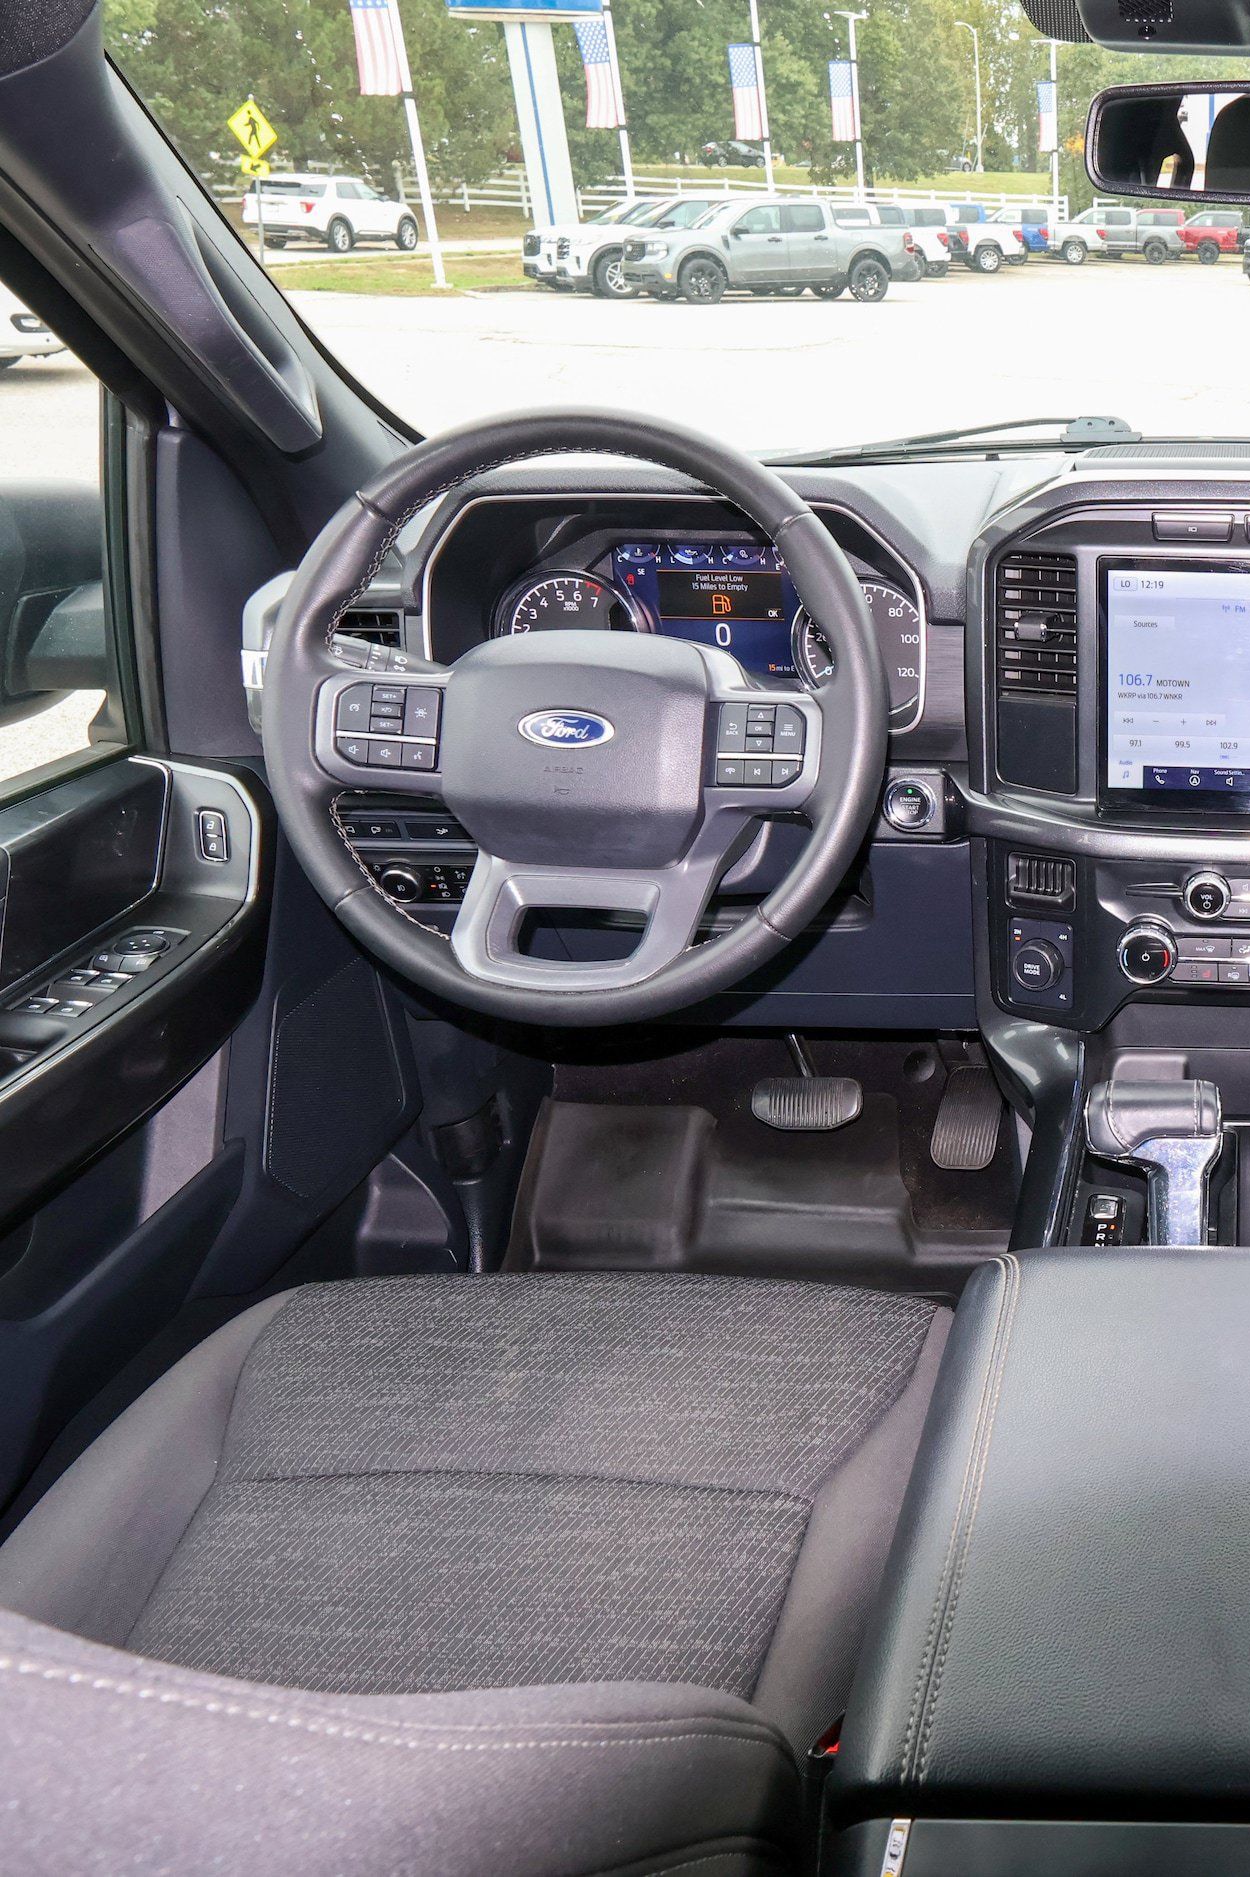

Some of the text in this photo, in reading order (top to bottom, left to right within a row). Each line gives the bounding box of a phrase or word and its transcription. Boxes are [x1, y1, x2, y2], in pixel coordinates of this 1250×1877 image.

[696, 574, 743, 583] Fuel Level Low
[692, 582, 699, 590] 15
[718, 583, 726, 591] to
[727, 584, 749, 592] Empty
[1120, 580, 1164, 589] LO 12:19
[556, 590, 565, 601] 5
[573, 591, 582, 601] 6
[540, 597, 548, 607] 4
[590, 597, 599, 608] 7
[529, 608, 538, 619] 3
[888, 607, 903, 617] 80
[1234, 605, 1246, 613] FM
[768, 610, 778, 618] OK
[1133, 620, 1158, 628] Sources
[715, 622, 732, 647] 0
[900, 634, 919, 644] 100
[897, 667, 915, 677] 120
[1118, 673, 1190, 688] 106.7 MOTOWN
[1147, 692, 1163, 700] 106.7
[540, 716, 591, 740] Ford
[1129, 739, 1142, 747] 97.1
[1174, 741, 1191, 749] 99.5
[1220, 742, 1238, 750] 102.9
[1152, 767, 1168, 775] Phone
[1097, 1223, 1108, 1231] P
[1096, 1233, 1106, 1241] R
